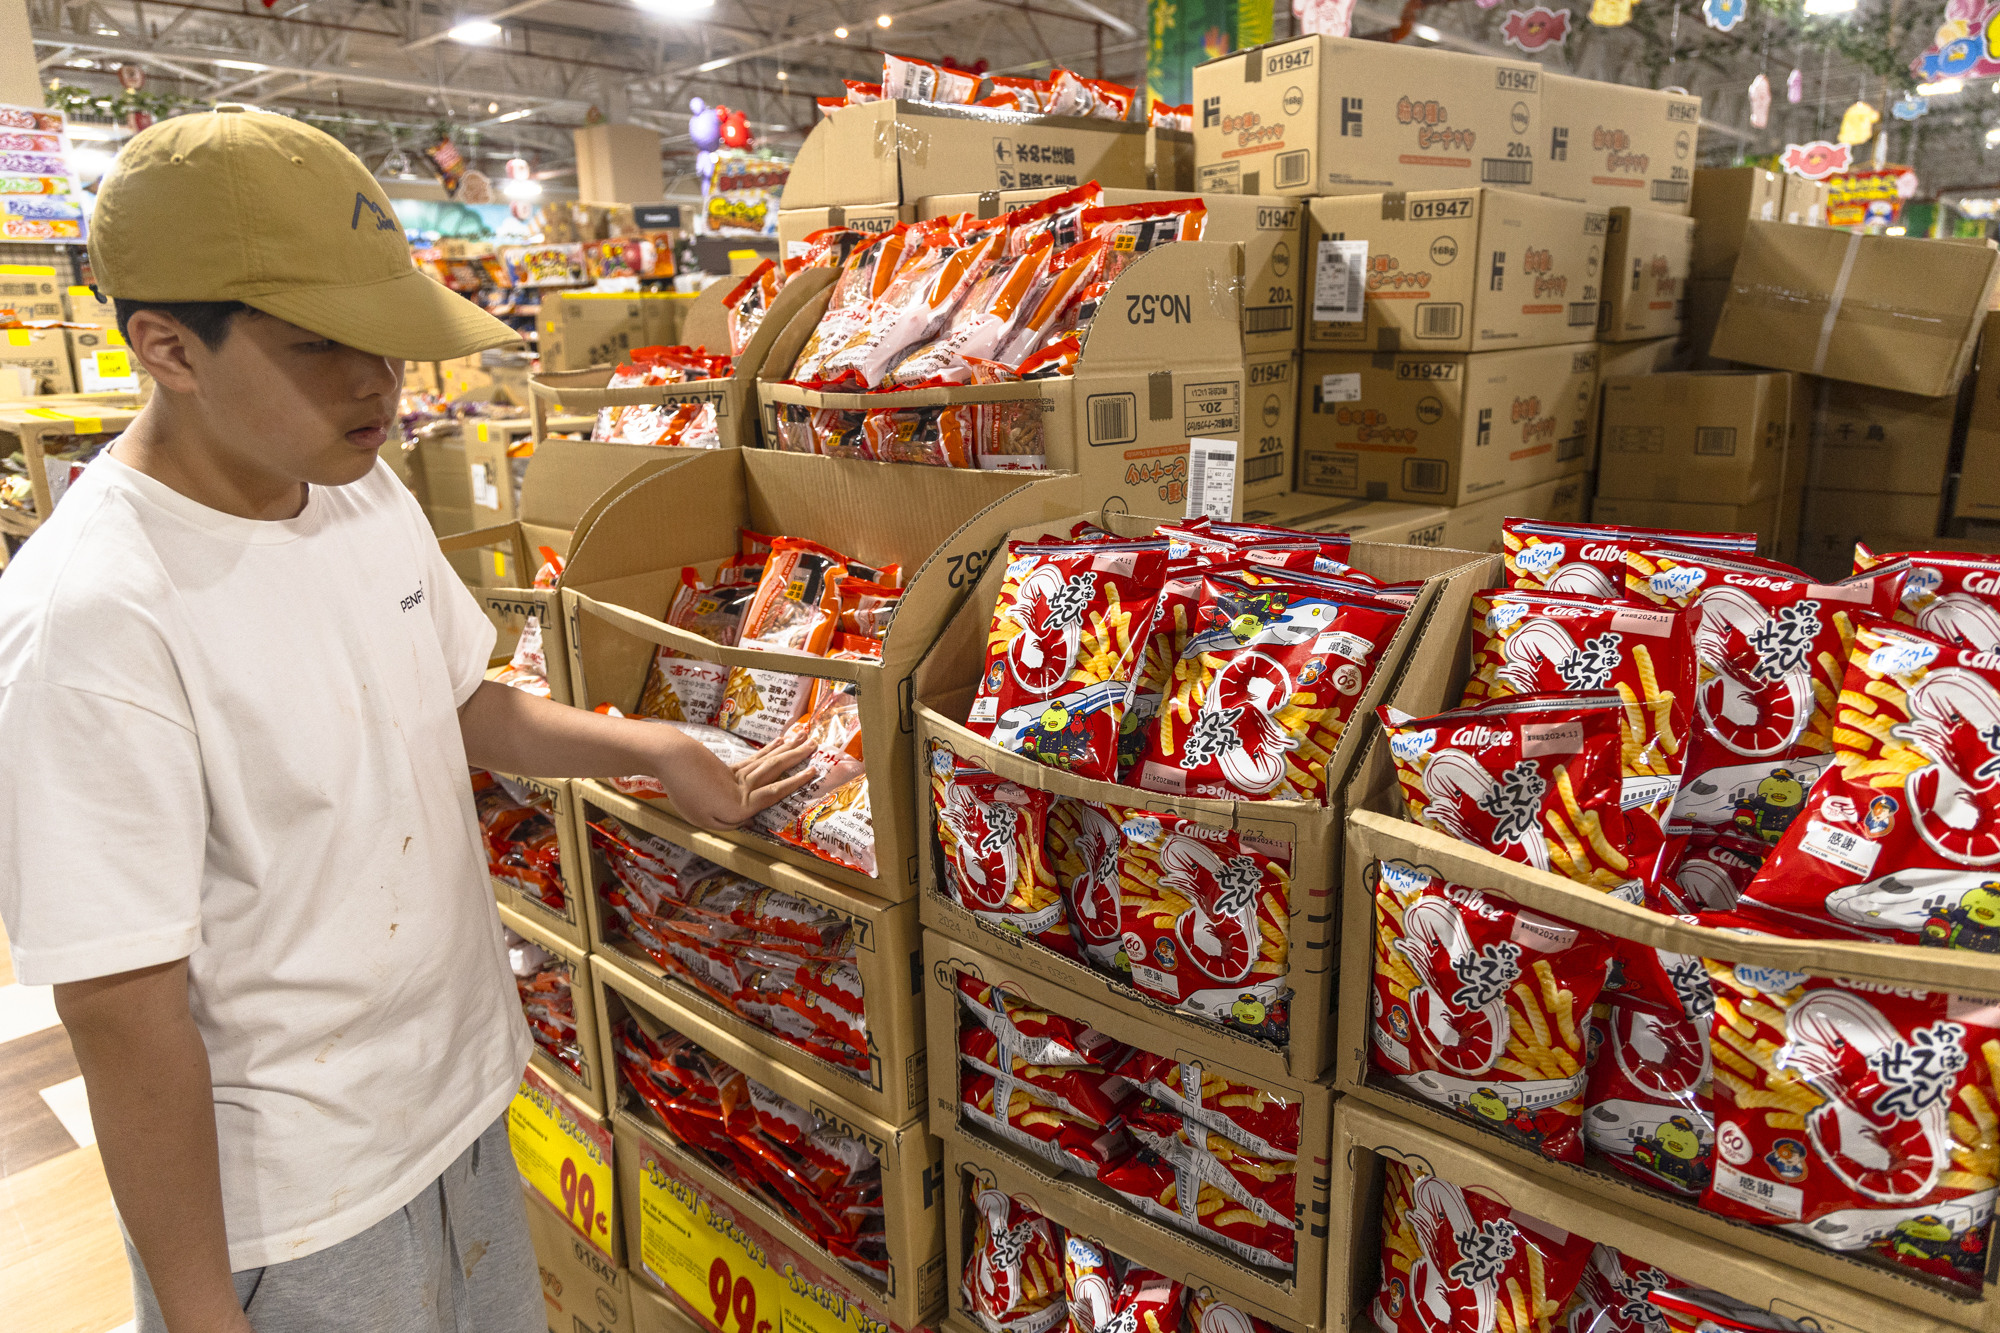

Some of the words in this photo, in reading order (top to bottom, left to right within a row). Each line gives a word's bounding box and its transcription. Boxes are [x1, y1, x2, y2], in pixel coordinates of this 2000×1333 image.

[1270, 51, 1310, 73] 01947
[1500, 70, 1537, 89] 01947
[1419, 127, 1476, 151] ピーナッツ
[1016, 142, 1076, 165] 水ぬれ注意
[1507, 142, 1533, 159] 20入
[1259, 210, 1296, 227] 01947
[1413, 200, 1469, 218] 01947
[850, 219, 892, 233] 01947
[1432, 245, 1455, 257] 168g
[1368, 271, 1432, 289] ピーナッツ
[1269, 287, 1293, 304] 20入
[1126, 294, 1191, 325] No.52
[1252, 364, 1287, 383] 01947
[1401, 363, 1454, 379] 01947
[1199, 401, 1222, 414] 20入
[991, 422, 999, 450] PEANUTS
[1260, 436, 1284, 454] 20入
[1125, 456, 1187, 485] ピーナッツ
[1409, 526, 1444, 548] 01947
[1517, 545, 1563, 566] カルシウム
[1580, 543, 1628, 563] Calbe
[1080, 573, 1097, 601] かっぱ
[1652, 571, 1703, 591] カルシウム
[1796, 601, 1820, 637] かっぱ
[1599, 635, 1621, 667] かっぱ
[768, 684, 797, 698] なく使用
[1391, 728, 1434, 752] カルシウム
[1450, 726, 1513, 747] Calbee
[1516, 761, 1544, 795] かっぱ
[1828, 831, 1858, 852] 感謝
[1443, 881, 1506, 922] Calbee
[1125, 937, 1141, 952] 60
[1496, 942, 1521, 980] かっぱ
[1143, 966, 1164, 984] 感謝
[1722, 1129, 1744, 1151] 60
[1739, 1175, 1774, 1198] 感謝
[646, 1158, 699, 1217] Special
[699, 1198, 767, 1270] Discount
[574, 1243, 618, 1287] 01947
[783, 1263, 847, 1324] Special
